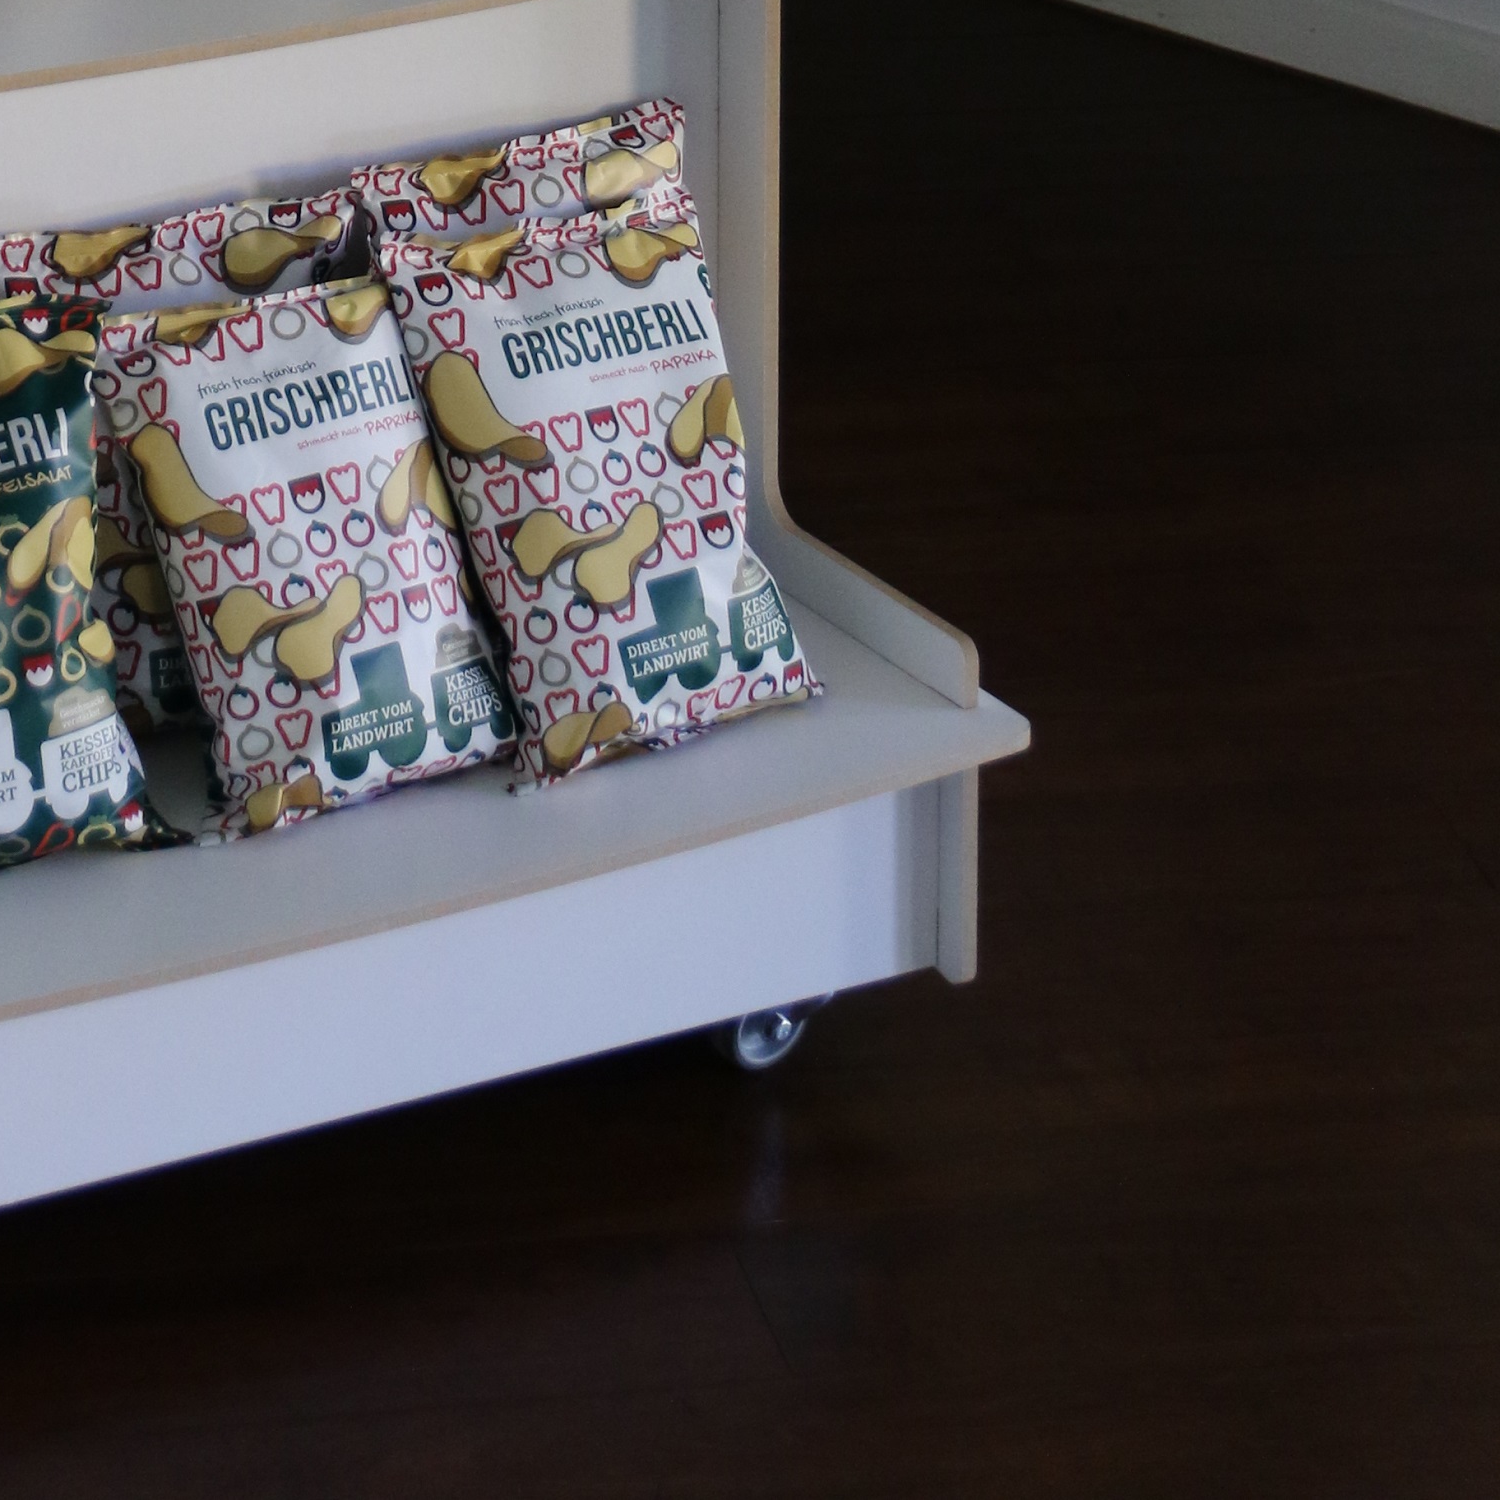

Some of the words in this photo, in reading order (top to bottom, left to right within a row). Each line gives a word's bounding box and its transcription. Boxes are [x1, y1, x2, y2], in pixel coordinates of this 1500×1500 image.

[523, 309, 554, 327] frech
[554, 297, 604, 317] fränkisch
[501, 298, 709, 380] GRISCHBERLI
[197, 378, 231, 399] frisch
[232, 374, 263, 391] frech
[262, 359, 317, 384] fränkisch
[649, 349, 718, 375] PAPRIKA
[204, 352, 417, 451] GRISCHBERLI
[363, 409, 422, 437] PAPRIKA
[626, 634, 678, 659] DIREKT
[679, 624, 708, 643] VOM
[744, 614, 788, 650] CHIPS
[631, 641, 710, 678] LANDWIRT
[445, 662, 490, 694] KESSEL
[330, 710, 380, 736] DIREKT
[381, 699, 413, 720] VOM
[448, 691, 503, 727] CHIPS
[59, 724, 118, 761] KESSEL
[331, 717, 415, 755] LANDWIRT
[62, 759, 122, 794] CHIPS
